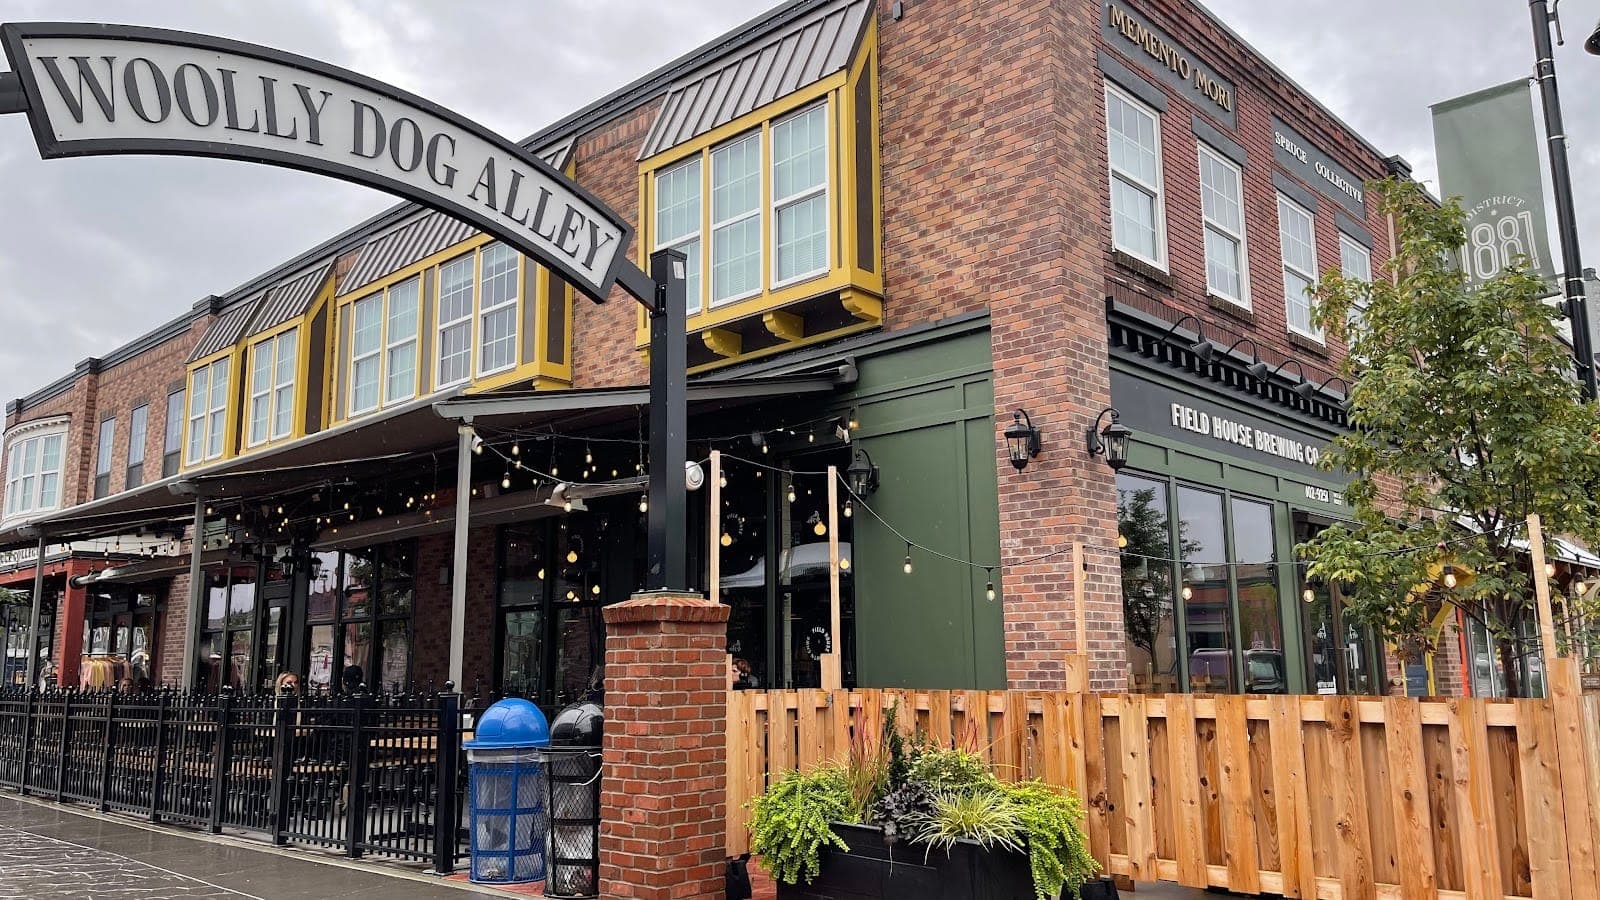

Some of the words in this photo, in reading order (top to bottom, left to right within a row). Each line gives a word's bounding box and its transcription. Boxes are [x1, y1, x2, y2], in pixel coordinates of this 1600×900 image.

[1109, 4, 1190, 80] MEMENTO
[1194, 68, 1231, 112] MORI
[37, 56, 332, 146] WOOLLY
[350, 99, 459, 189] DOG
[468, 156, 613, 271] ALLEY
[1274, 131, 1308, 164] SPRUCE
[1315, 162, 1363, 203] COLLECTIVE
[1465, 196, 1525, 221] DISTRICT
[1461, 211, 1541, 282] 1881
[1171, 403, 1210, 435] FIELD
[1212, 416, 1254, 448] HOUSE
[1254, 429, 1304, 463] BREWING
